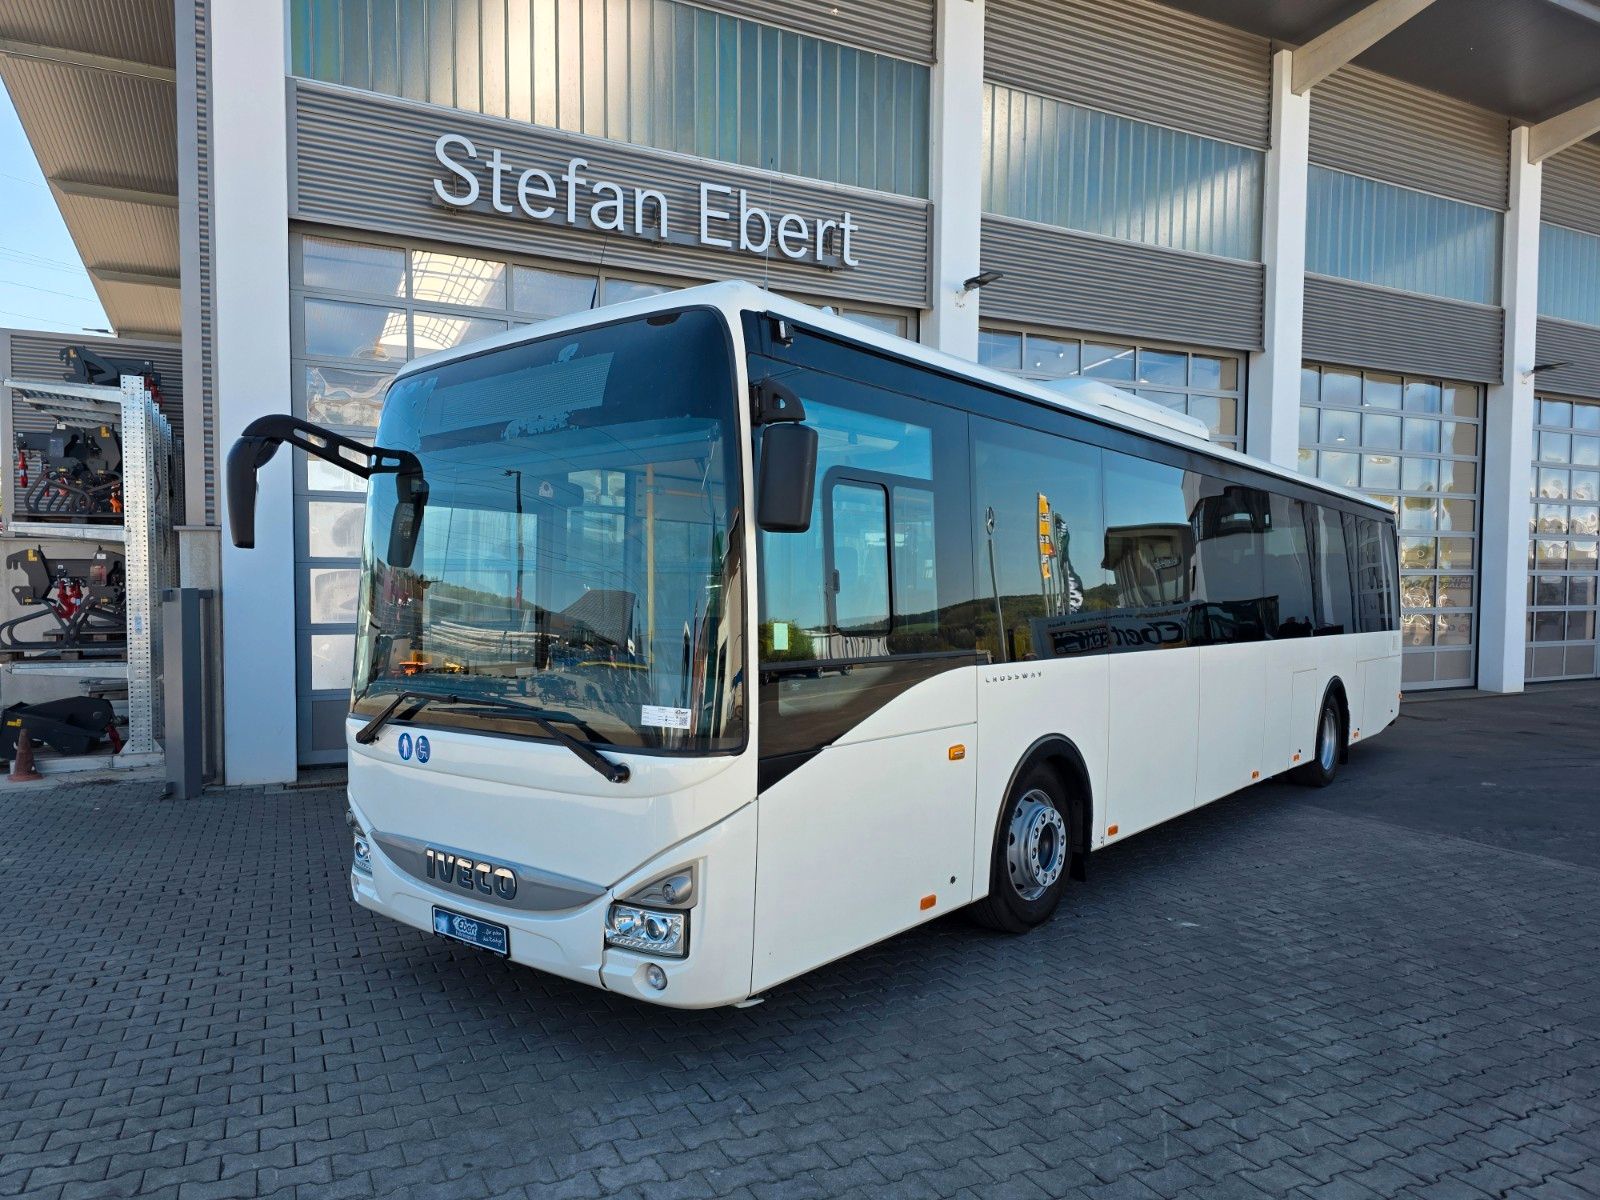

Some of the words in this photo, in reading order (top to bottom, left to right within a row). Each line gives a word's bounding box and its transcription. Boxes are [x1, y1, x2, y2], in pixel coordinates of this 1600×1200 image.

[433, 133, 669, 239] Stefan
[699, 182, 860, 267] Ebert
[426, 849, 518, 901] IVECO
